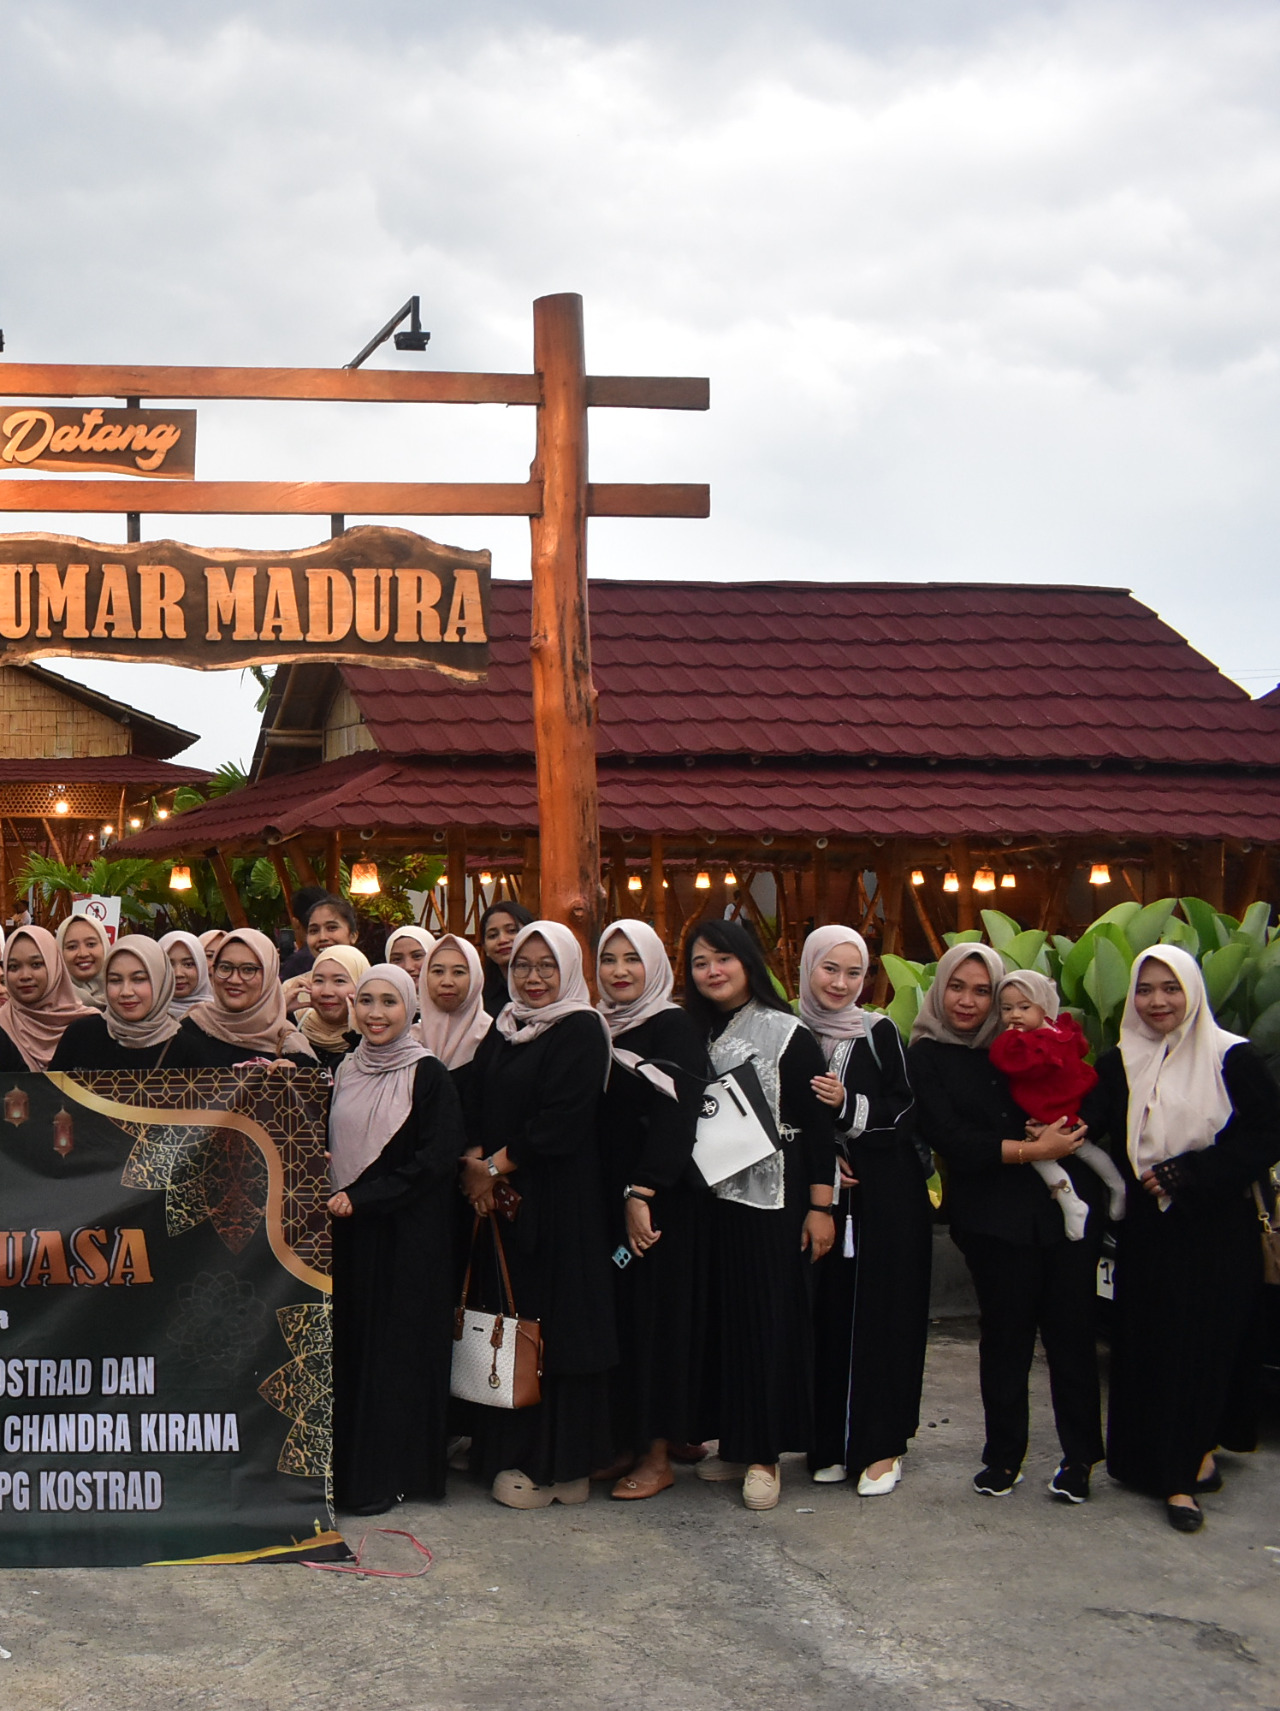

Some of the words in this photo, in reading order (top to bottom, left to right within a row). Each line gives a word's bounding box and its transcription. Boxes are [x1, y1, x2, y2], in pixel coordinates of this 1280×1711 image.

[1, 408, 180, 471] Datang
[204, 566, 488, 644] MADURA
[101, 1356, 155, 1395] DAN
[3, 1413, 131, 1453] CHANDRA
[140, 1413, 240, 1452] KIRANA
[39, 1471, 162, 1511] KOSTRAD
